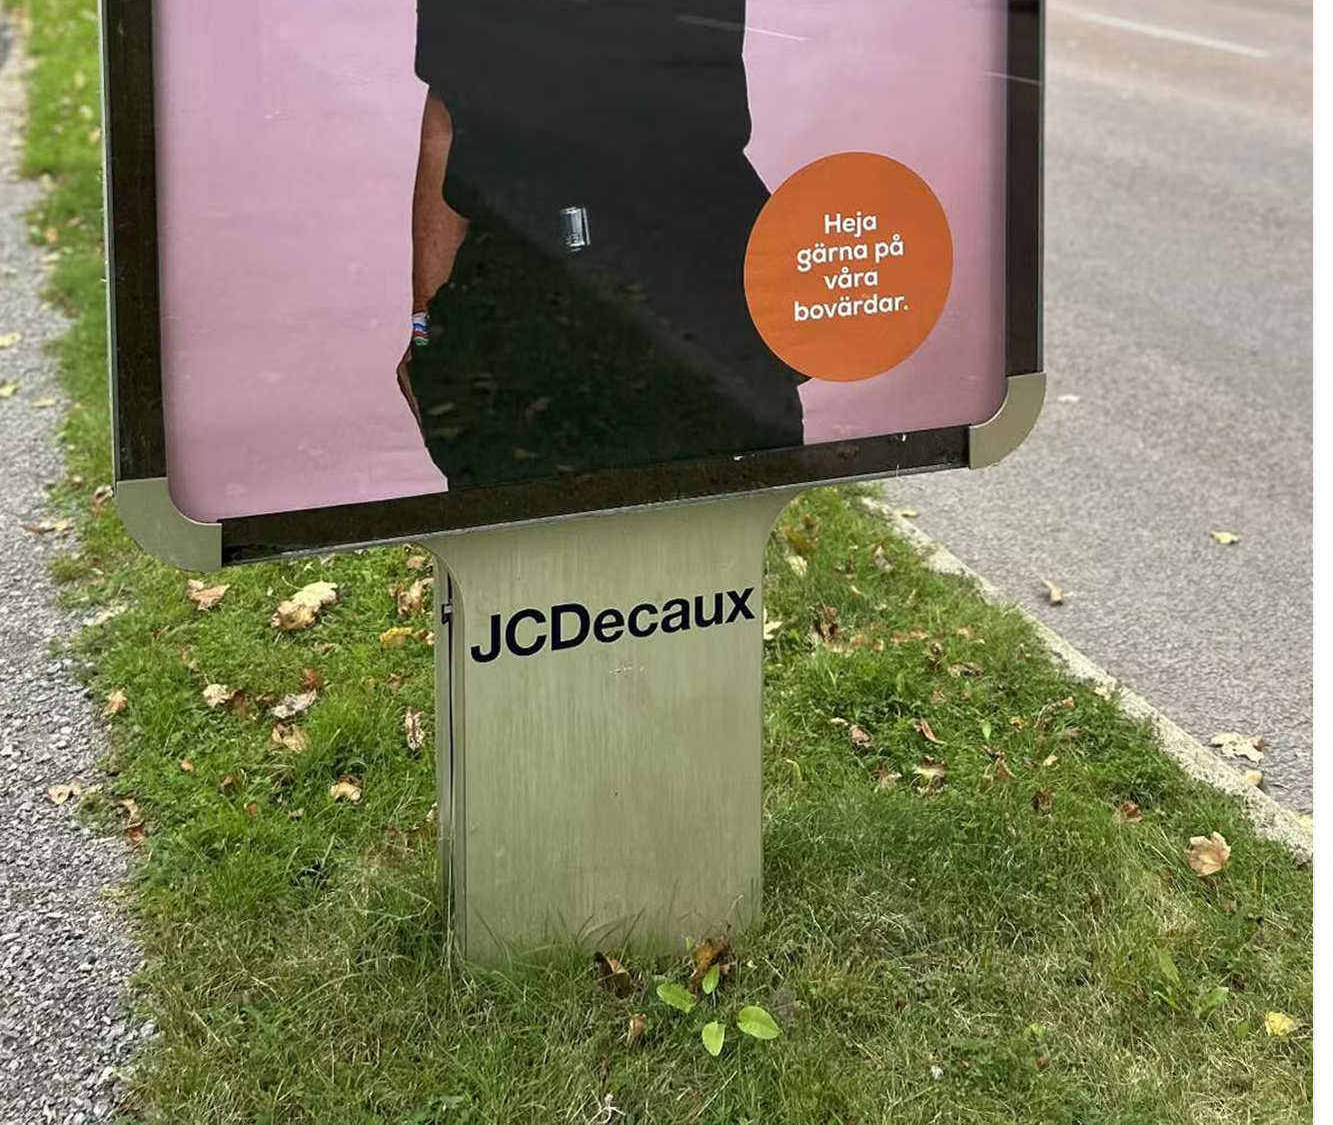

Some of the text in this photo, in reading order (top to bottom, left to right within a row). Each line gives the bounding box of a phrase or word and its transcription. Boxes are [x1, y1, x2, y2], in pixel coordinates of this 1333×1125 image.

[824, 211, 877, 237] Heja
[797, 234, 904, 272] gärna på
[824, 266, 879, 290] våra
[793, 294, 909, 321] bovärdar.
[470, 586, 756, 663] JCDecaux
